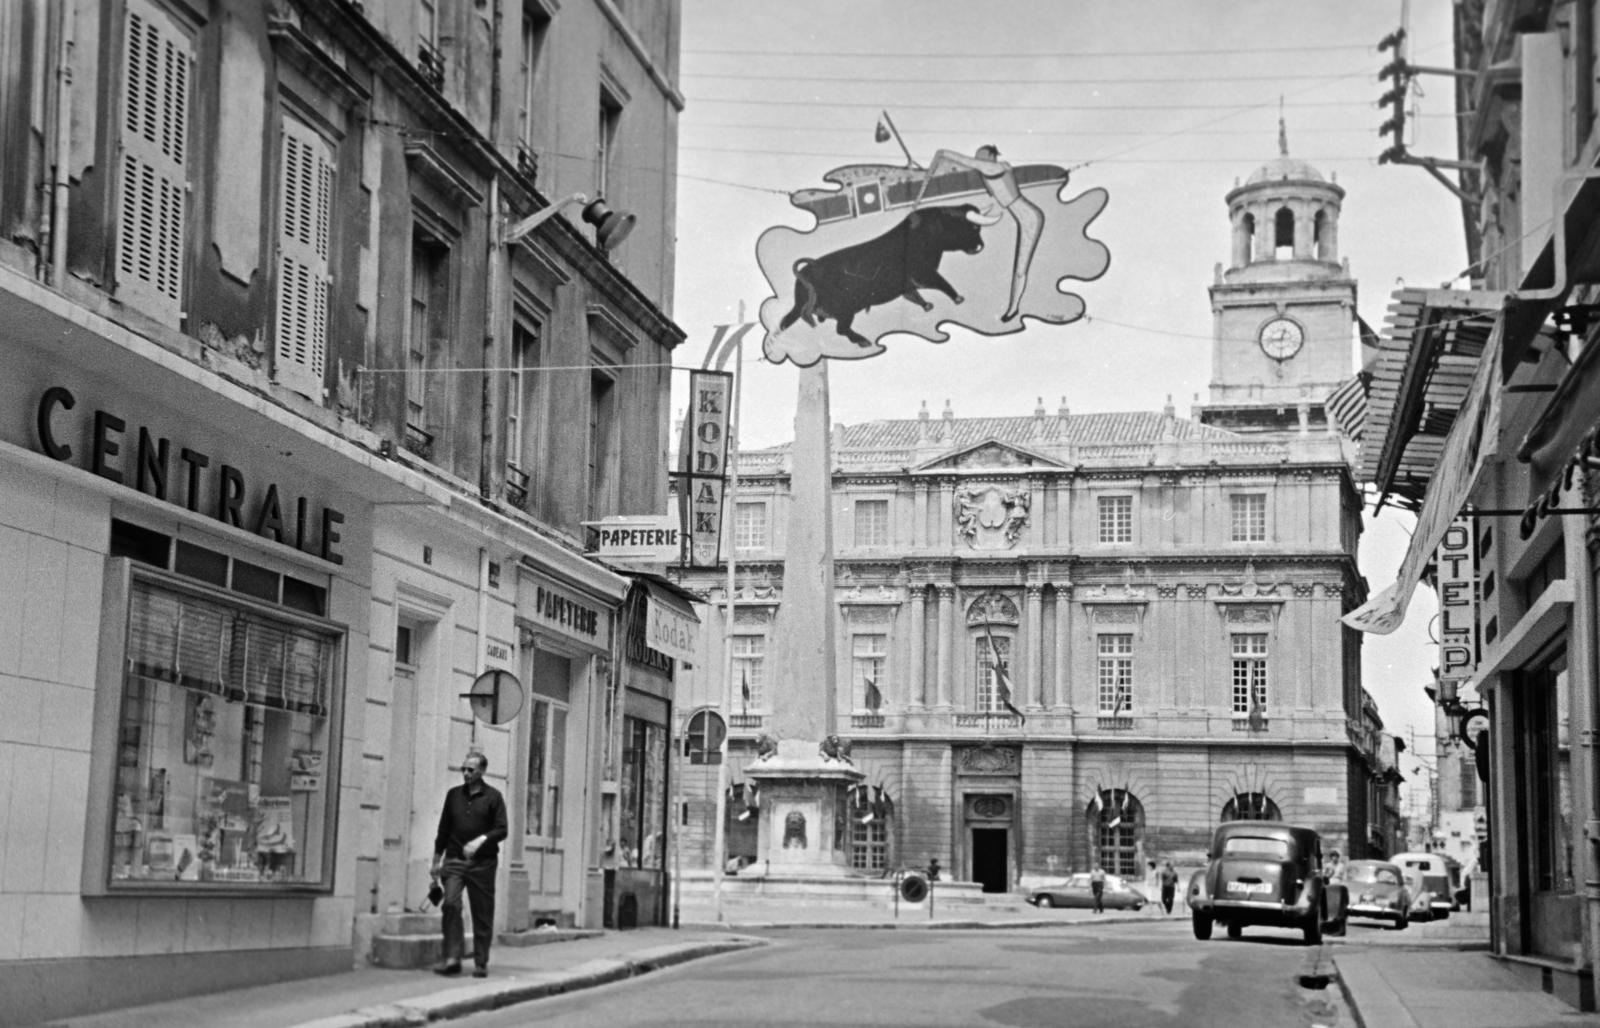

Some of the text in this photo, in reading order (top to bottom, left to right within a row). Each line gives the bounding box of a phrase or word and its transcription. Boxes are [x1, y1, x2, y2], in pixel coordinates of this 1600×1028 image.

[37, 386, 345, 566] CENTRALE
[696, 390, 723, 533] KODAK
[601, 529, 678, 546] PAPETERIE
[1441, 516, 1470, 634] OTEL
[536, 586, 598, 636] PAPETERIE
[654, 607, 696, 653] Kodak
